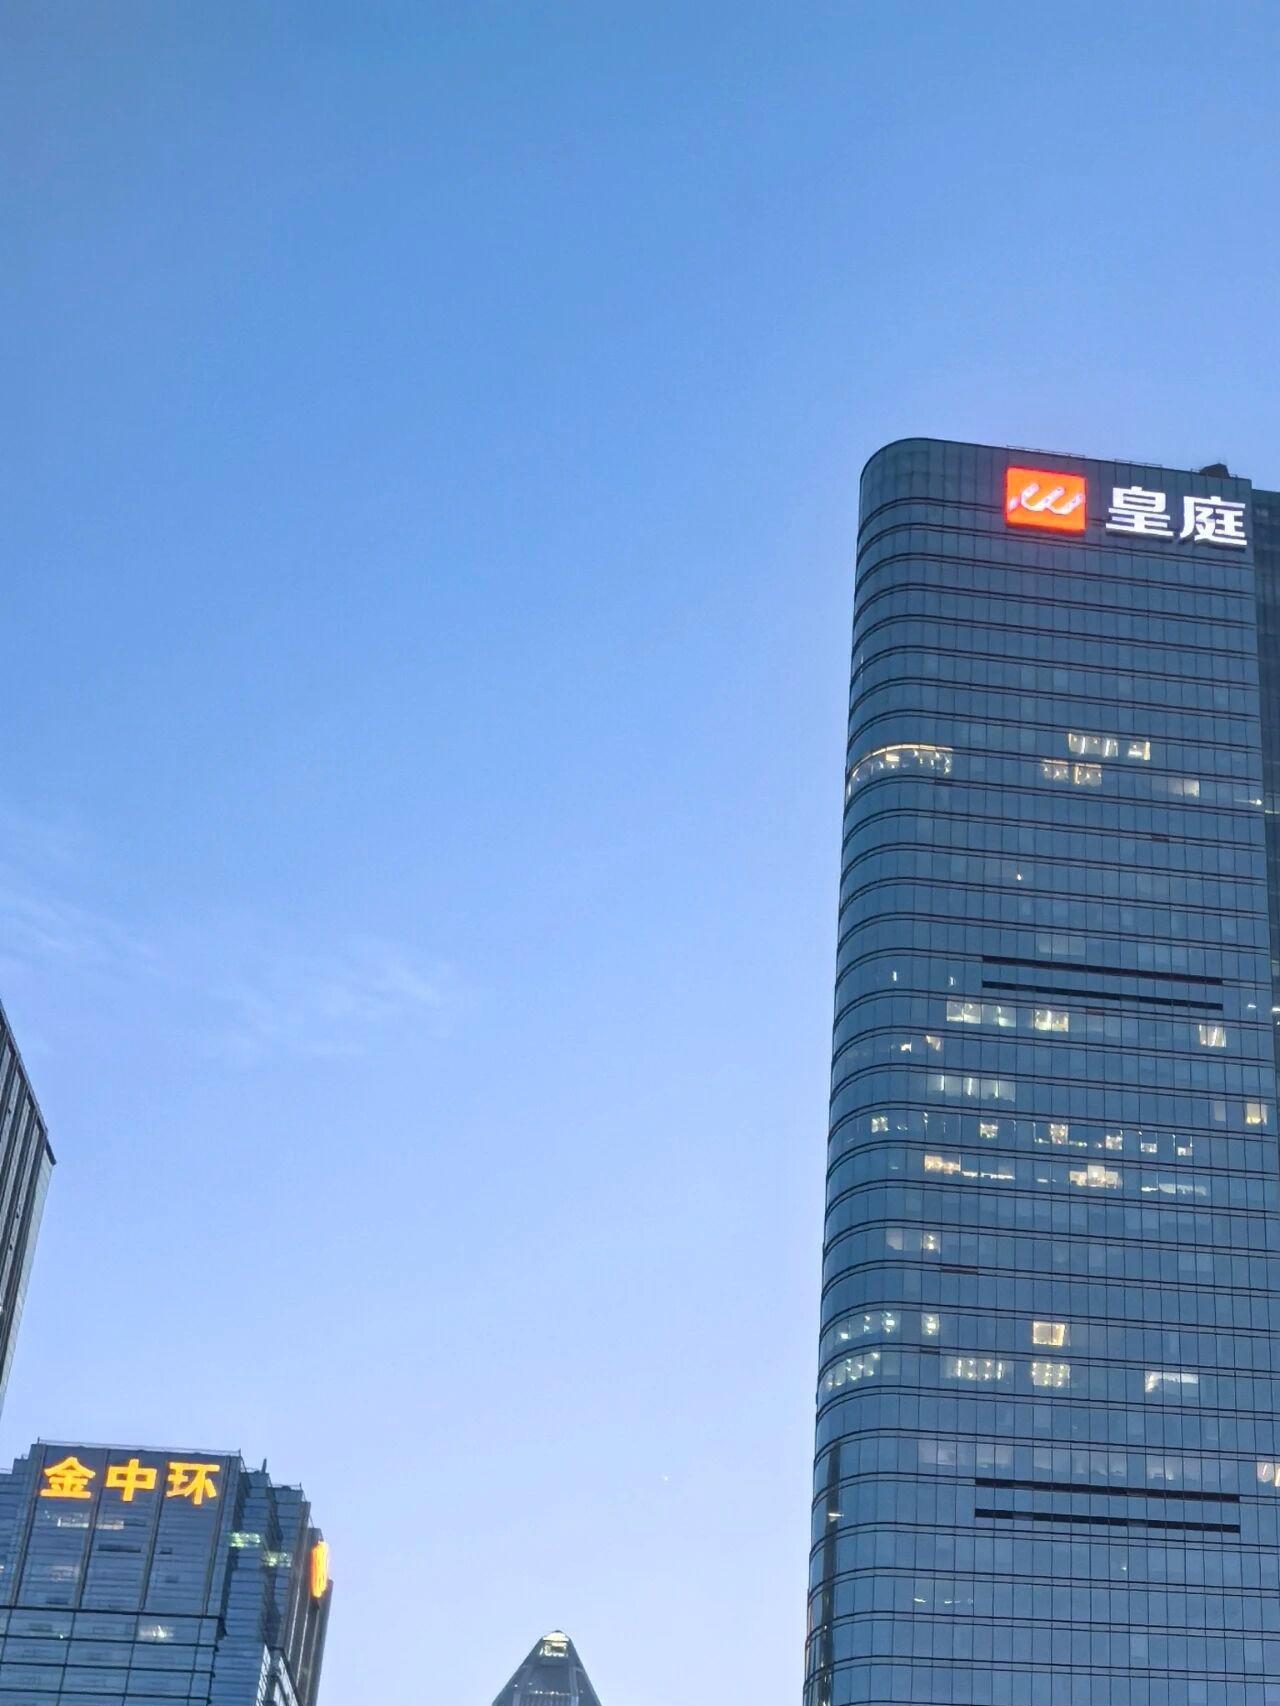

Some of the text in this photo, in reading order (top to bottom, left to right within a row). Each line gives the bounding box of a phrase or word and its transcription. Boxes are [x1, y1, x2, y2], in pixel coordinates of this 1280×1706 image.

[1105, 486, 1248, 546] 皇庭
[40, 1456, 221, 1505] 金中环
